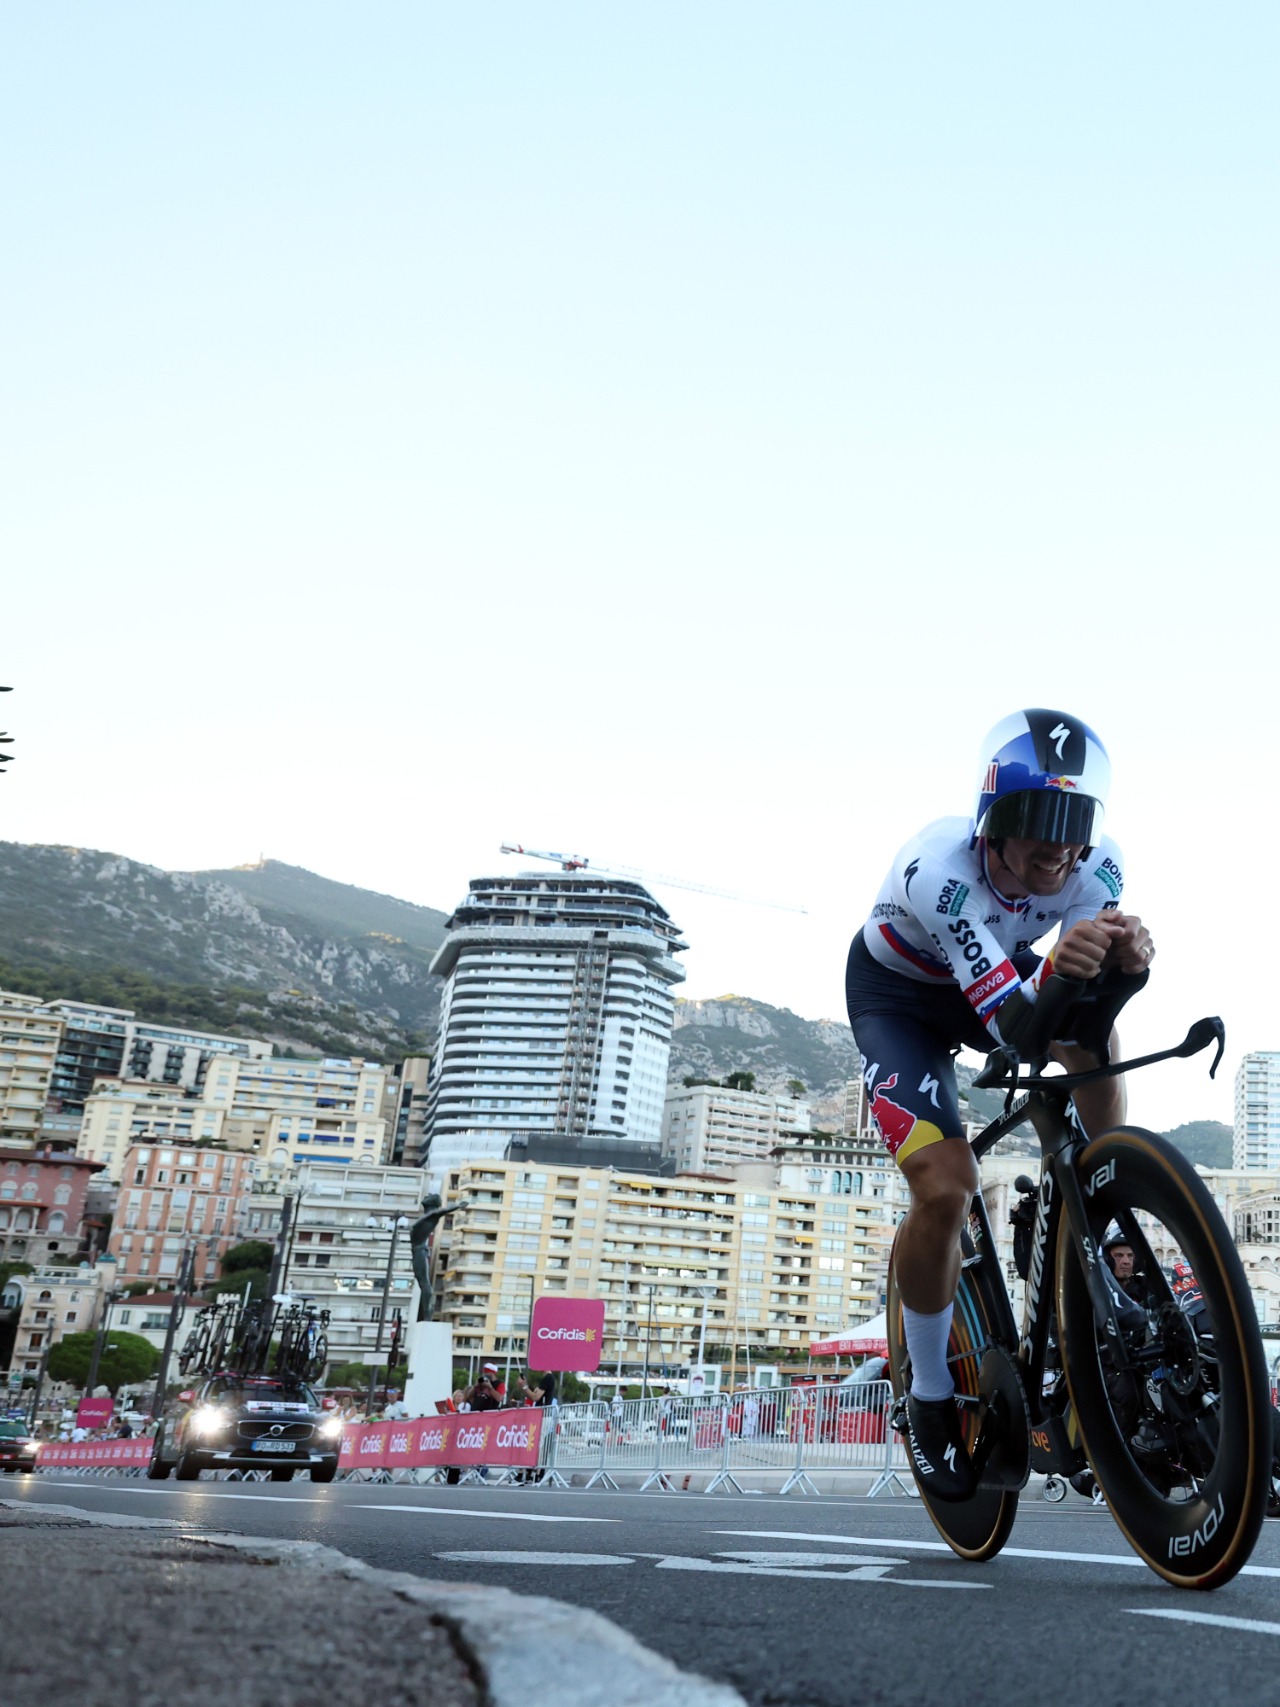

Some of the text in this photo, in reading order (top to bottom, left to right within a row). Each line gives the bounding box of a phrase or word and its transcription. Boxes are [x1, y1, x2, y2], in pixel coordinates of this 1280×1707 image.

[936, 879, 960, 914] BORA
[949, 919, 992, 979] BOSS
[968, 971, 1005, 1003] mewa
[1084, 1158, 1116, 1197] val
[537, 1327, 586, 1340] Cofidis
[360, 1432, 382, 1454] Cofidis
[389, 1431, 408, 1453] Cofidis
[420, 1429, 443, 1450] Cofidis
[456, 1427, 483, 1448] Cofidis
[496, 1424, 529, 1448] Cofidis
[1168, 1492, 1225, 1559] roval
